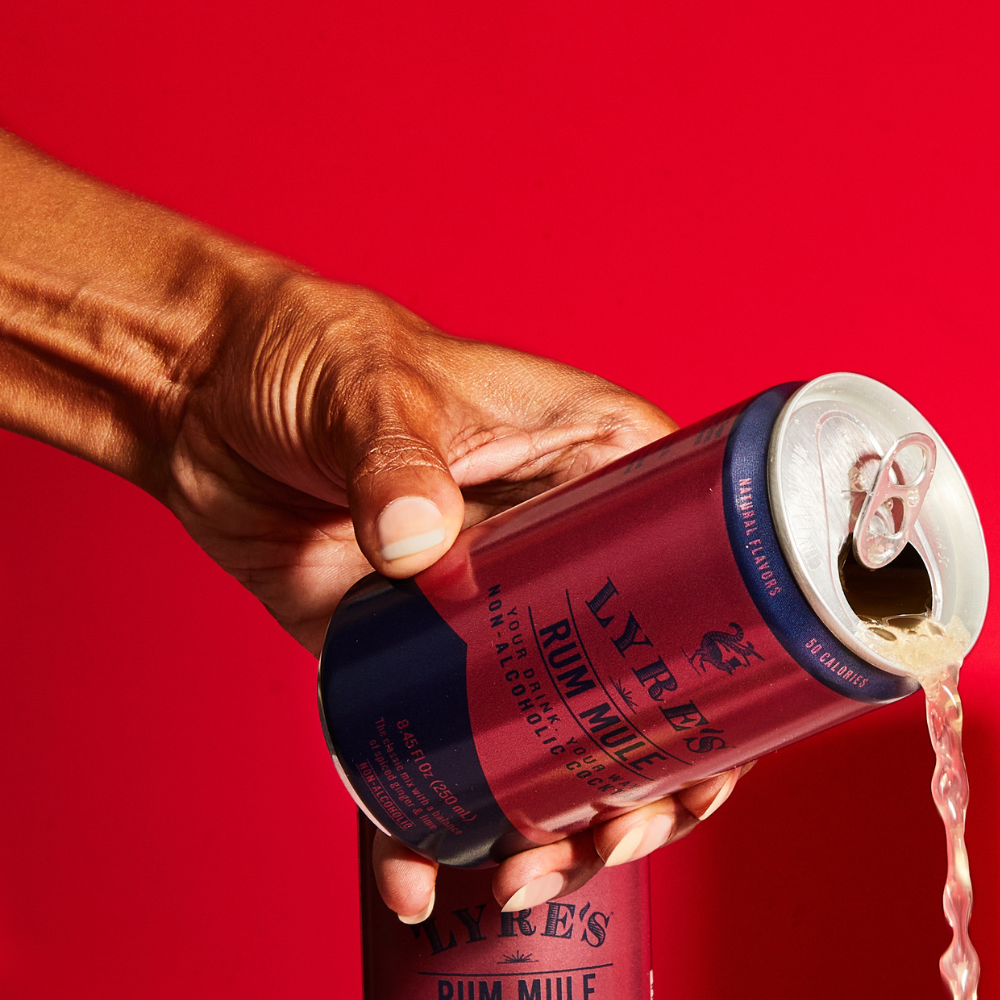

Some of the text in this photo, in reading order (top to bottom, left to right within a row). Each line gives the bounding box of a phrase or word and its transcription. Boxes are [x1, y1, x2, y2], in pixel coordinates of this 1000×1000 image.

[738, 478, 781, 597] NATURAL FLAVORS
[488, 584, 634, 798] NON-ALCOHOLIC COCKT
[507, 606, 527, 660] YOUR
[523, 667, 560, 732] DRINK.
[566, 736, 605, 772] YOUR
[538, 618, 668, 771] RUM MULE
[585, 576, 728, 754] LYRE'S
[805, 638, 870, 688] 50 CALORIES
[358, 761, 413, 830] NON-ALCOHOLIC
[369, 739, 379, 750] of
[374, 751, 397, 781] spiced
[389, 781, 416, 808] ginger
[412, 807, 423, 816] &
[375, 717, 386, 737] The
[382, 738, 404, 771] classic
[400, 772, 415, 788] mix
[411, 788, 429, 806] with
[432, 810, 463, 835] balance
[396, 719, 418, 749] 8.45
[419, 762, 434, 779] Oz
[429, 780, 458, 805] (250
[452, 805, 477, 822] mL)
[422, 900, 612, 957] LYRE'S
